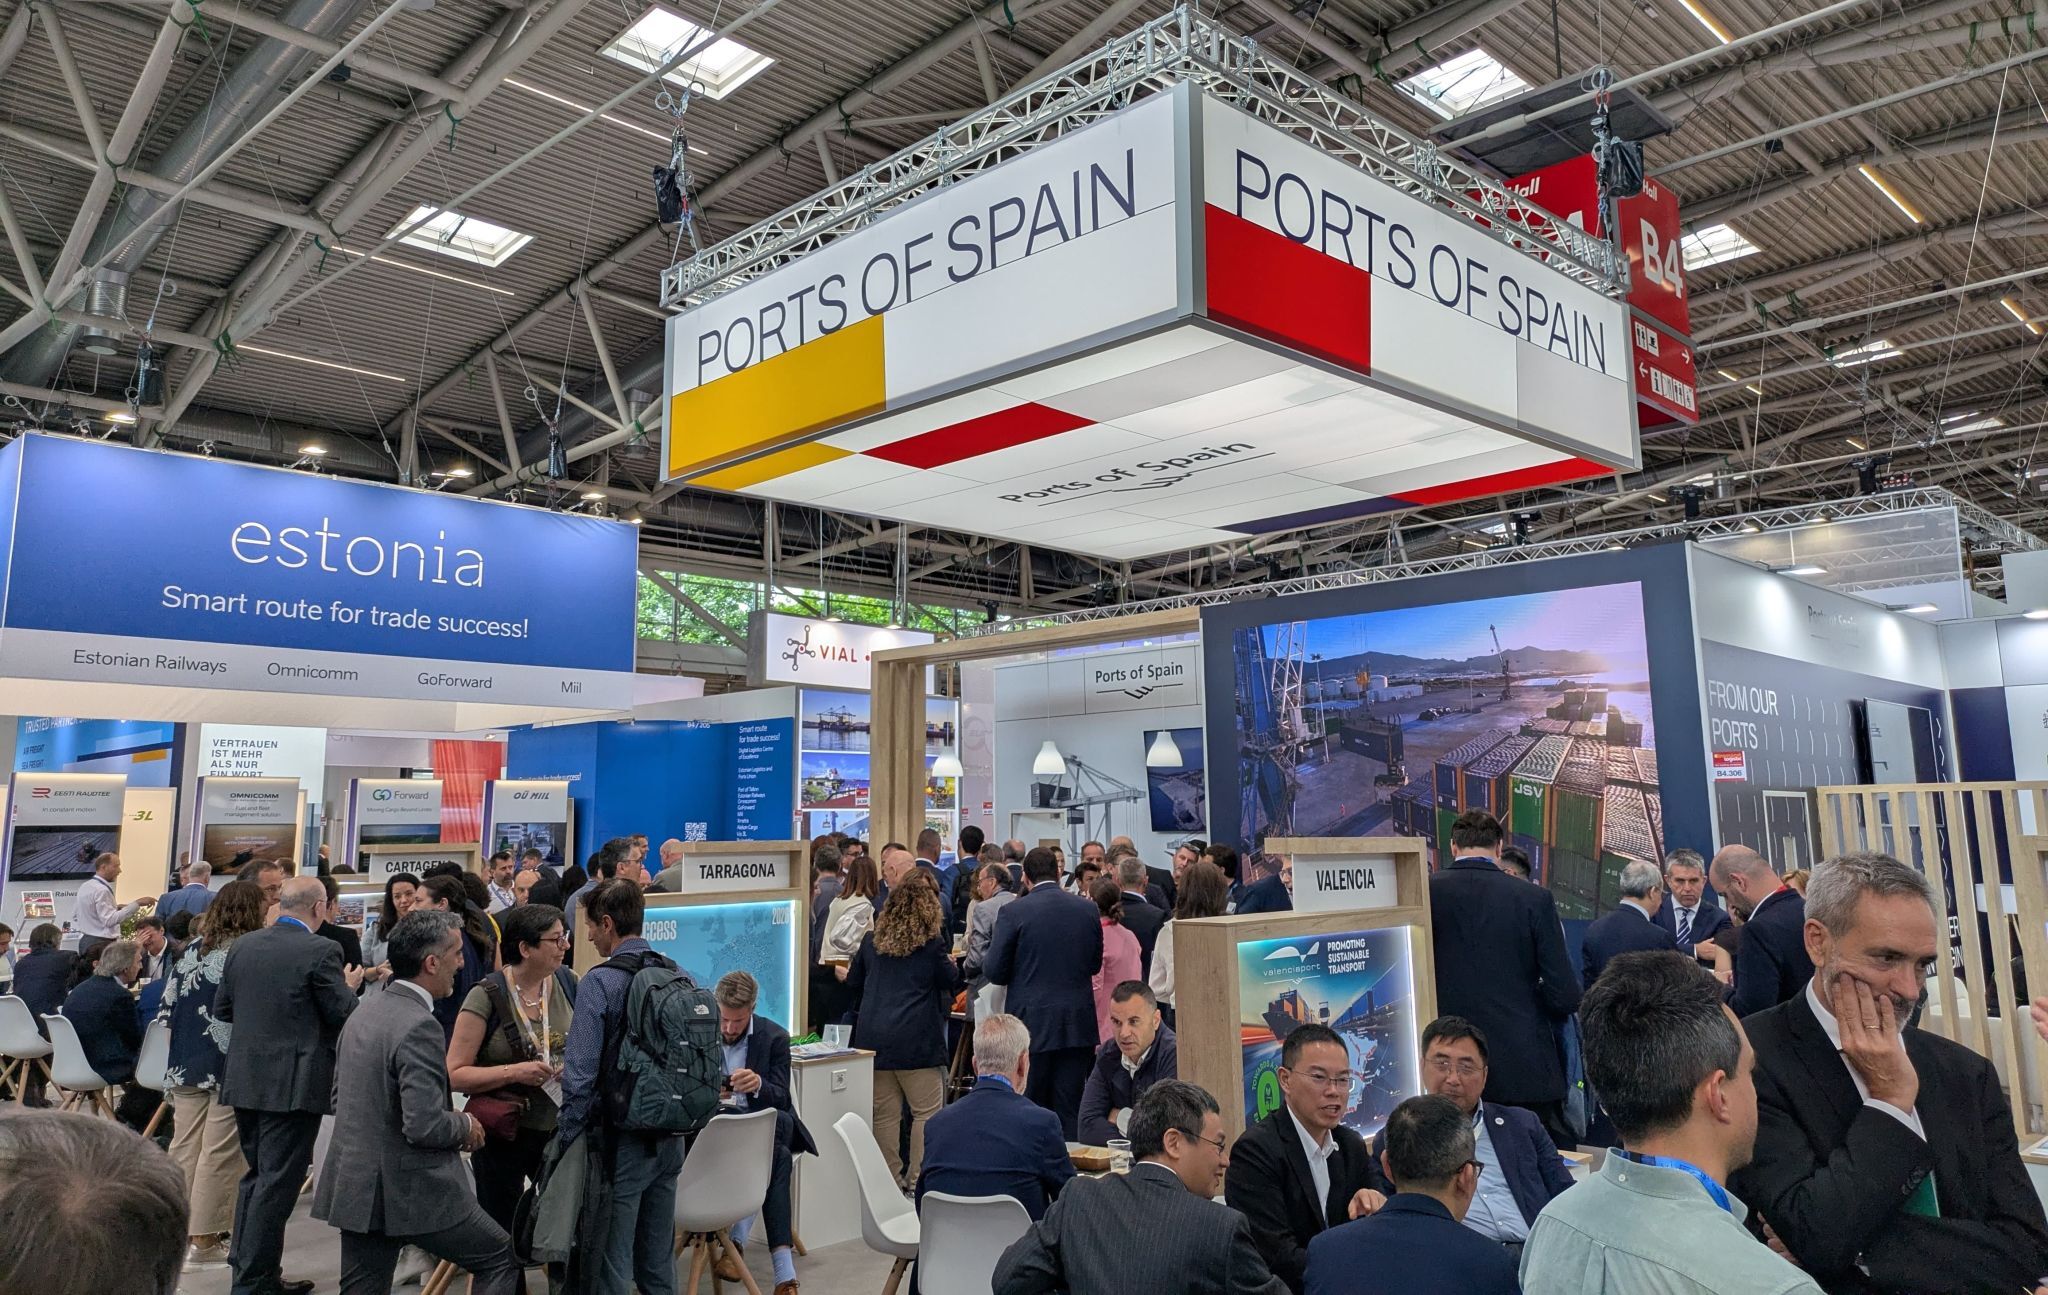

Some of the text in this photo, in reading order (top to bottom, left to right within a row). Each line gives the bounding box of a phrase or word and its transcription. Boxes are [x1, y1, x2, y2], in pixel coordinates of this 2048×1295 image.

[1642, 178, 1658, 201] Hall
[1236, 148, 1606, 374] PORTS OF SPAIN
[1640, 217, 1684, 300] B4
[698, 148, 1136, 387] PORTS OF SPAIN
[997, 442, 1257, 503] Ports of Spain
[230, 516, 485, 588] estonia
[162, 584, 529, 639] Smart route for trade success!
[820, 644, 858, 663] VIAL
[73, 649, 227, 676] Estonian Railways
[267, 662, 359, 681] Omnicomm
[1095, 661, 1184, 683] Ports of Spain
[417, 672, 493, 689] GoForward
[561, 681, 582, 694] Miil
[1708, 679, 1779, 716] FROM OUR
[25, 718, 50, 734] TRUSTED
[739, 724, 768, 734] Smart route
[1711, 717, 1758, 750] PORTS
[212, 738, 278, 749] VERTRAUEN
[746, 735, 760, 743] trade
[760, 732, 781, 742] success!
[211, 750, 263, 759] IST MEHR
[210, 760, 258, 769] ALS NUR
[393, 790, 429, 800] Forward
[529, 791, 550, 800] MIIL
[1514, 783, 1544, 798] JSV
[699, 863, 776, 880] TARRAGONA
[1316, 867, 1376, 892] VALENCIA
[1327, 938, 1366, 952] PROMOTING
[1328, 949, 1370, 963] SUSTAINABLE
[1263, 962, 1321, 977] valenciaport
[1328, 961, 1366, 975] TRANSPORT
